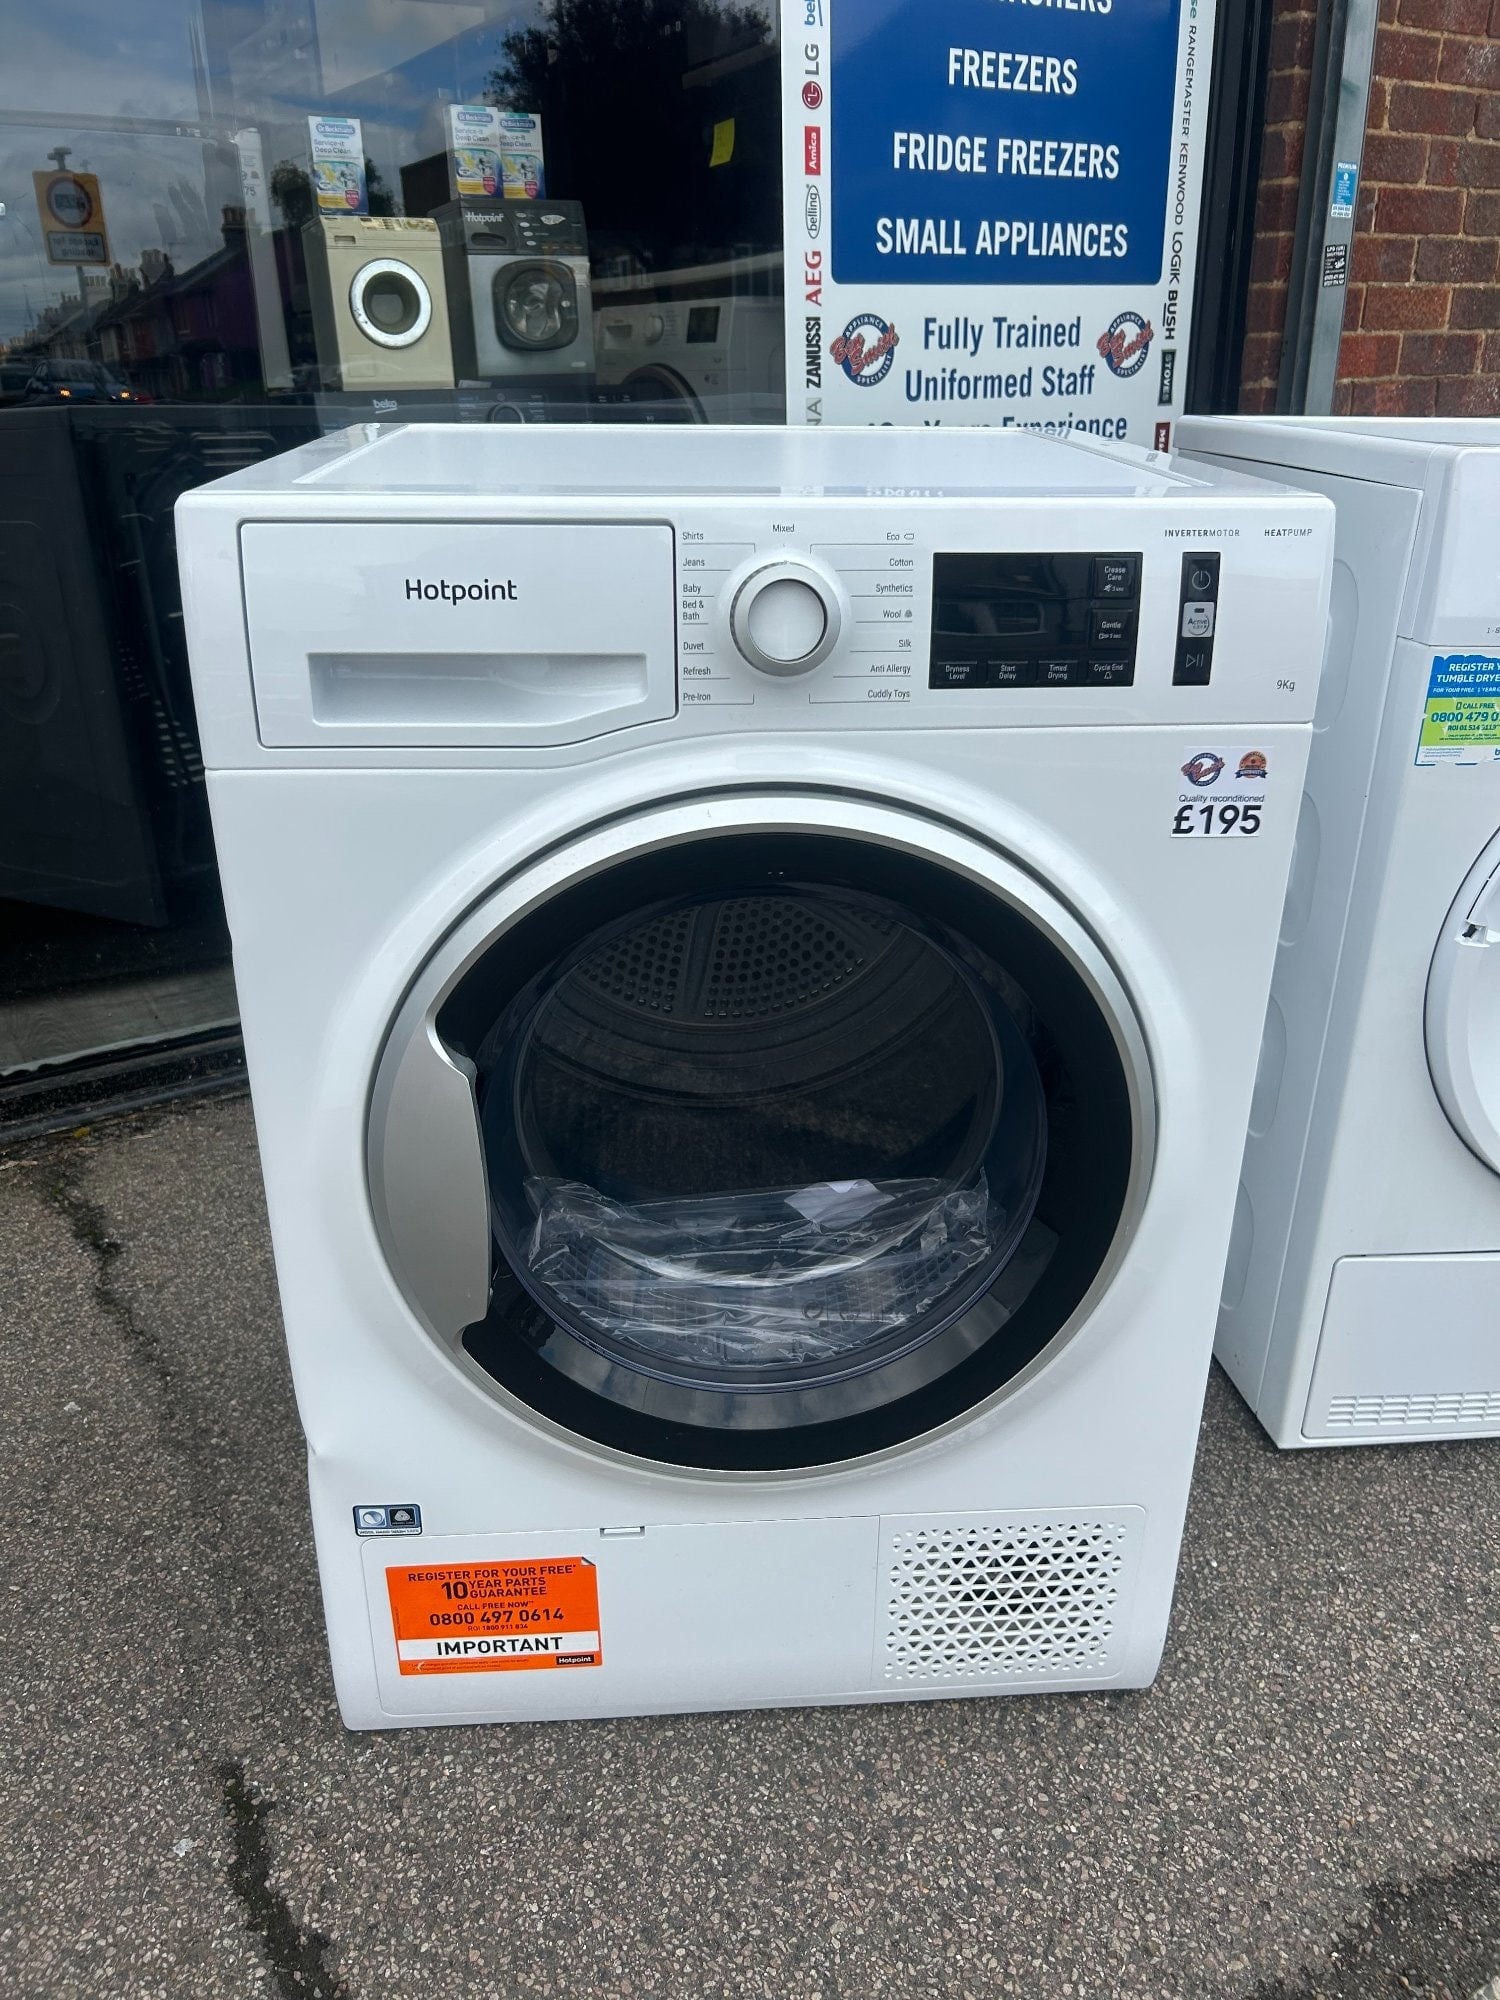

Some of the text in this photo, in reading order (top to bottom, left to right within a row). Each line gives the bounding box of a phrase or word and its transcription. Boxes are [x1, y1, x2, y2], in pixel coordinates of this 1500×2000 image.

[804, 0, 816, 26] be
[805, 44, 819, 75] LG
[948, 47, 1078, 95] FREEZERS
[1182, 25, 1197, 136] RANGEMASTER
[808, 132, 817, 169] Amica
[893, 132, 1120, 179] FRIDGE FREEZERS
[1175, 143, 1189, 225] KENWOOD
[807, 192, 818, 232] belling
[465, 212, 504, 224] Hotpoint
[876, 217, 1129, 258] SMALL APPLIANCES
[1169, 231, 1184, 285] LOGIK
[805, 250, 822, 307] AEG
[1164, 290, 1178, 340] BUSH
[923, 315, 1081, 357] Fully Trained
[806, 316, 821, 389] ZANUSSI
[906, 365, 1095, 402] Uniformed Staff
[373, 400, 398, 409] beko
[772, 524, 795, 533] Mixed
[1164, 528, 1313, 538] INVERTERMOTOR HEATPUMP
[682, 532, 704, 541] Shirts
[886, 532, 900, 541] Eco
[682, 559, 705, 567] Jeans
[889, 558, 914, 567] Cotton
[1104, 566, 1126, 574] Crease
[405, 578, 518, 606] Hotpoint
[683, 584, 702, 594] Baby
[875, 583, 913, 594] Synthetics
[682, 600, 704, 609] Bed &
[682, 612, 700, 620] Bath
[883, 610, 902, 619] Wool
[1101, 621, 1121, 629] Gentle
[683, 641, 704, 650] Duvet
[898, 639, 912, 648] Silk
[683, 667, 711, 675] Refresh
[870, 664, 911, 674] Anti Allergy
[945, 665, 970, 673] Dryness
[1049, 664, 1067, 672] Timed
[1094, 664, 1111, 672] Cycle
[1449, 663, 1494, 672] REGISTER
[949, 672, 966, 680] Level
[999, 672, 1017, 680] Delay
[1048, 671, 1068, 680] Drying
[1436, 674, 1474, 683] TUMBLE
[1276, 680, 1295, 691] 9Kg
[683, 693, 711, 701] Pre-Iron
[867, 690, 910, 699] Cuddly Toys
[1431, 712, 1463, 722] 0800
[1465, 712, 1488, 722] 479
[1179, 795, 1265, 804] Quality reconditioned
[1172, 805, 1261, 834] £195
[408, 1570, 471, 1582] REGISTER
[474, 1569, 498, 1578] FOR
[502, 1566, 536, 1577] YOUR
[441, 1577, 546, 1600] 10 YEAR PARTS
[469, 1586, 547, 1599] GUARANTEE
[429, 1608, 564, 1626] 0800 497 0614
[436, 1636, 563, 1656] IMPORTANT
[558, 1655, 591, 1665] Hotpoint
